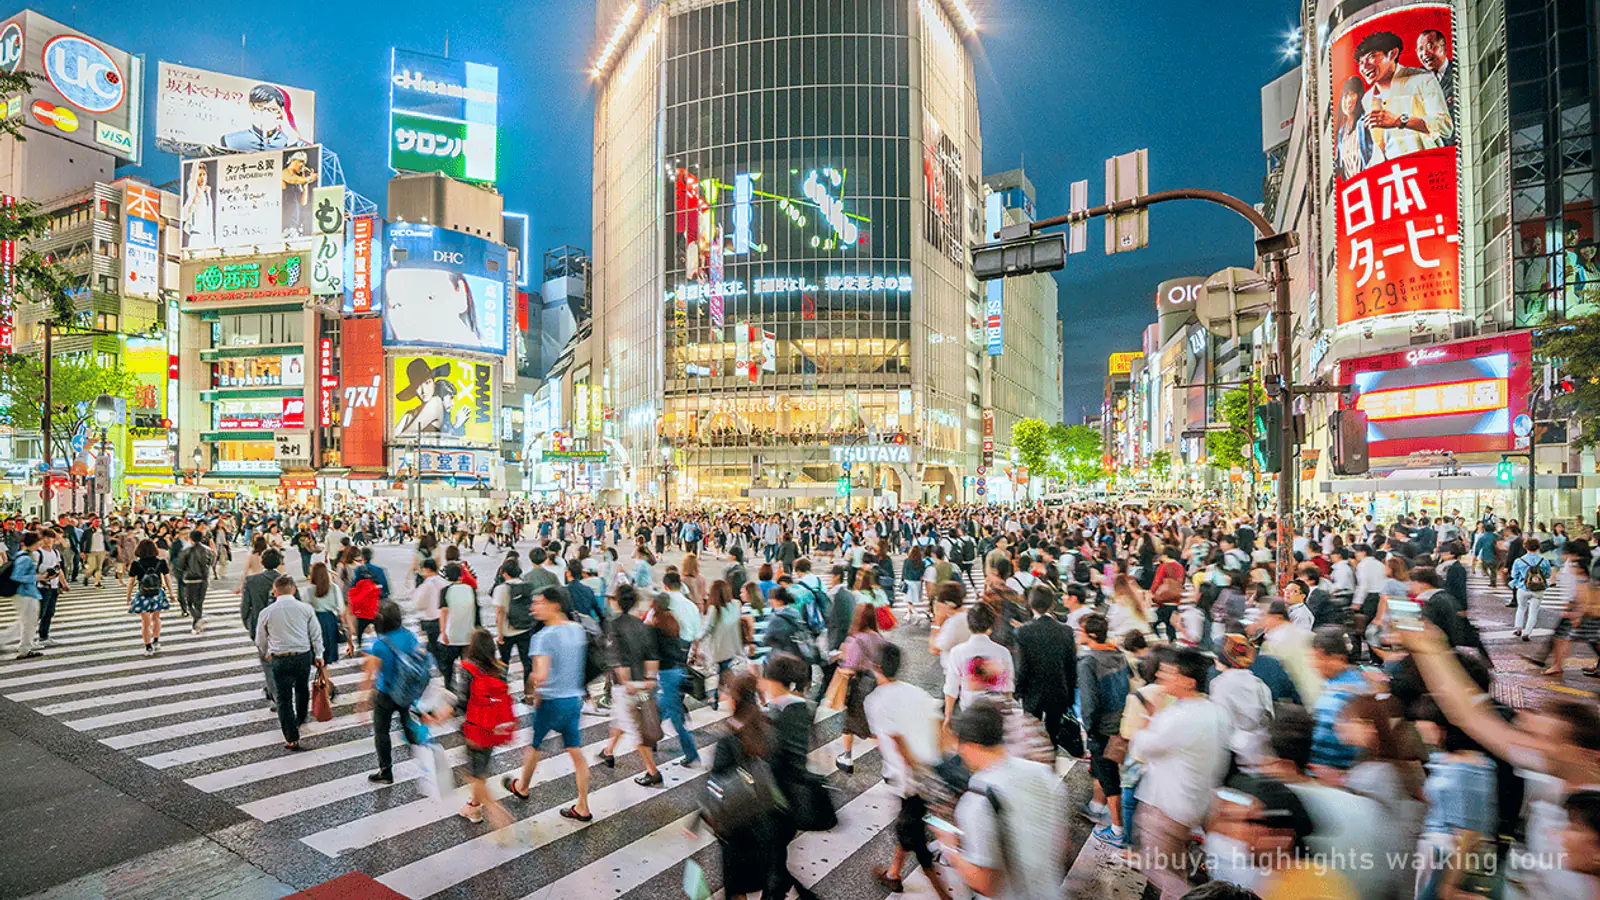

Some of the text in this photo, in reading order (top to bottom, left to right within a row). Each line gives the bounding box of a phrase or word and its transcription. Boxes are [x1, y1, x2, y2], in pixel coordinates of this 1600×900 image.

[54, 47, 118, 99] UC
[101, 129, 132, 148] VISA
[127, 187, 160, 220] 本
[1341, 163, 1428, 237] 日本
[314, 197, 343, 291] もんじゃ
[433, 250, 464, 265] DHC
[1348, 214, 1459, 289] ダービー
[1355, 282, 1398, 316] 5.29
[987, 300, 1001, 350] SEIBU
[220, 375, 280, 388] Euphoria
[457, 361, 475, 403] FX
[475, 363, 491, 424] DMM
[713, 400, 851, 414] STARBUCKS COFFEE
[832, 446, 911, 462] TSUTAYA
